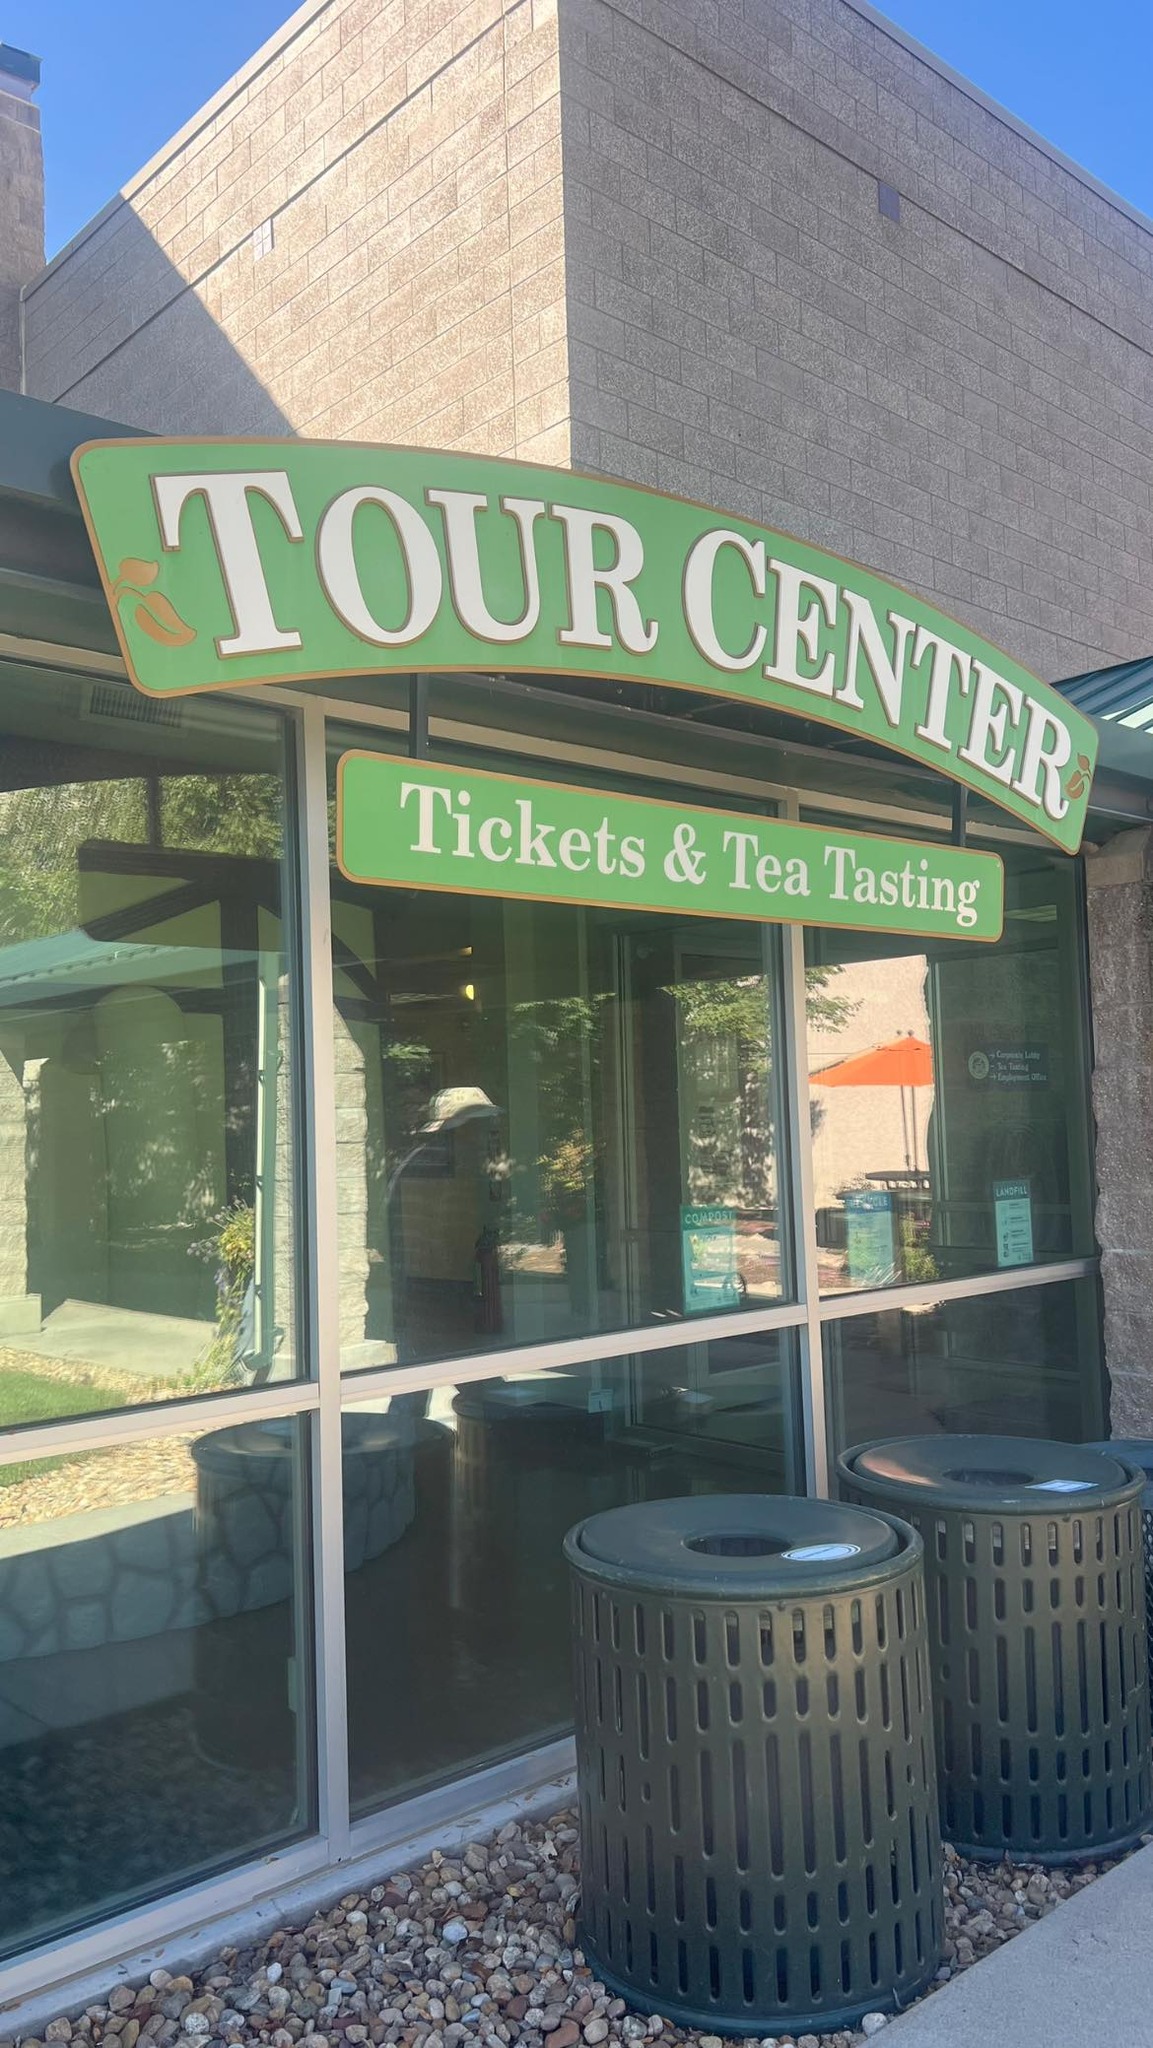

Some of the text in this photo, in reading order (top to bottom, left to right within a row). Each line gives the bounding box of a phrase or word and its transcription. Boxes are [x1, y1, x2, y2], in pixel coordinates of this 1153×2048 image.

[151, 471, 1071, 820] TOUR CENTER
[401, 782, 981, 928] Tickets & Tea Tasting
[685, 1210, 733, 1224] COMPOST
[995, 1186, 1027, 1197] LANDFILL
